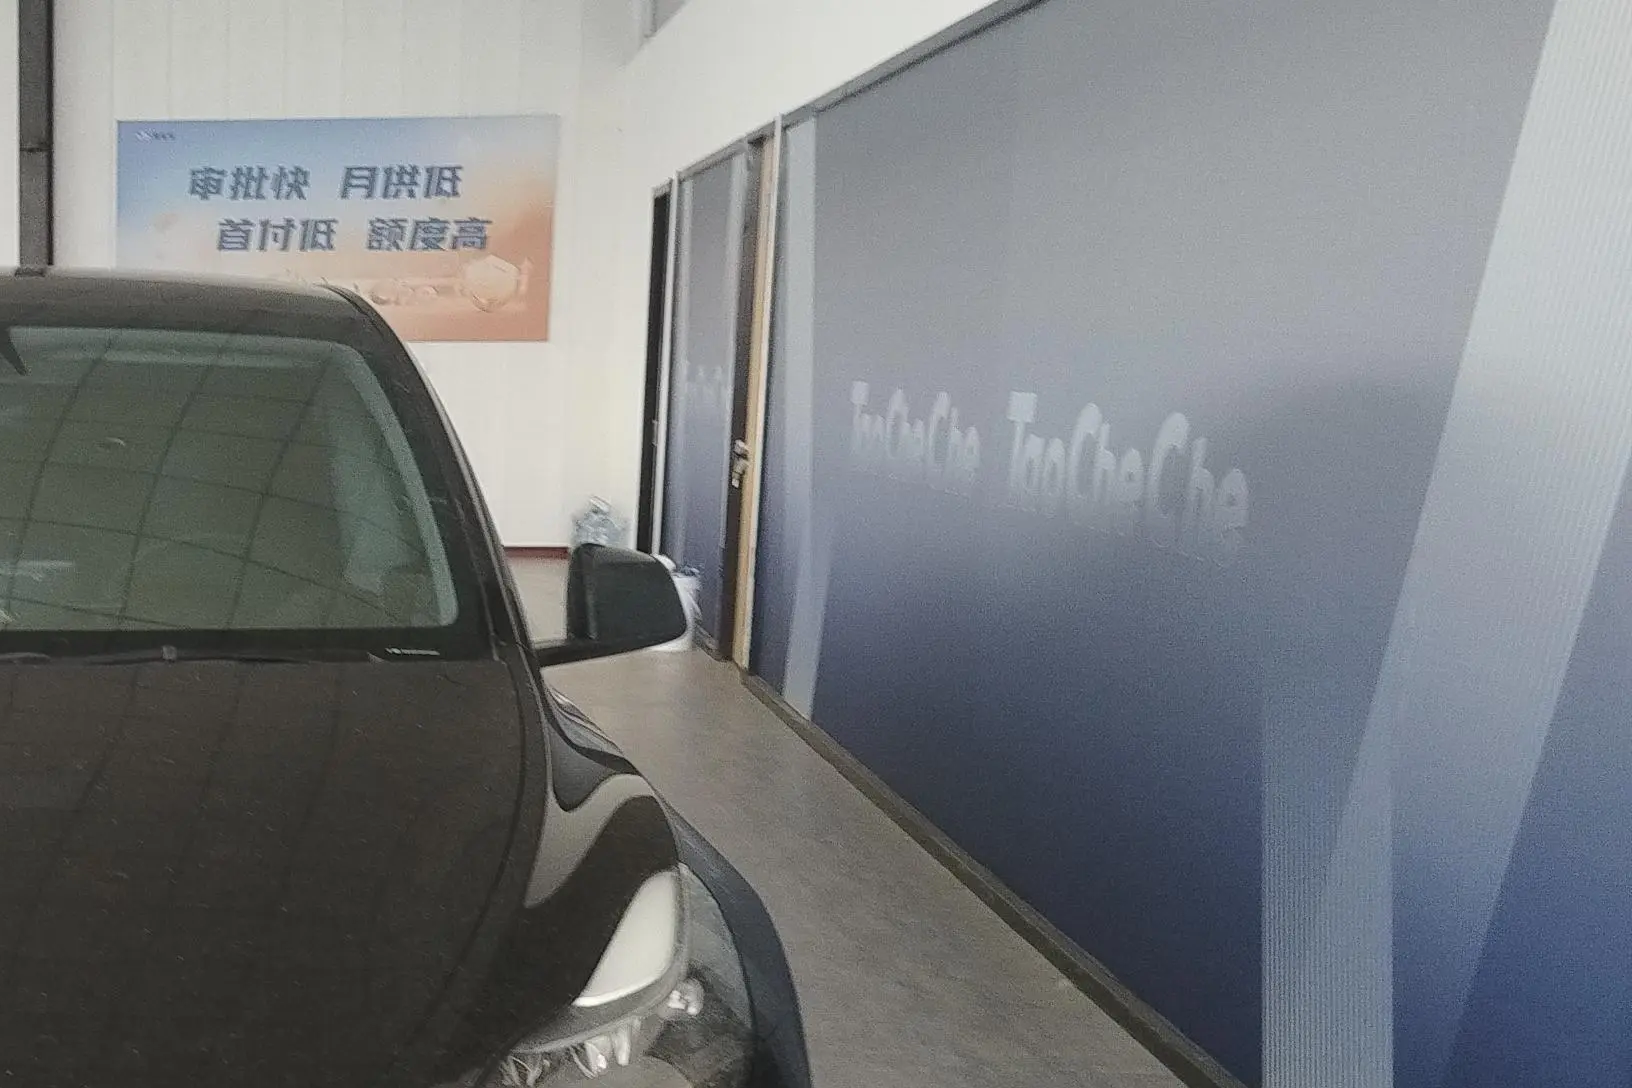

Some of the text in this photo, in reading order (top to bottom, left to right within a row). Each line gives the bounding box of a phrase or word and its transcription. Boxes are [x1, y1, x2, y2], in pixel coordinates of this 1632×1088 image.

[189, 164, 464, 200] 审批快 月供低
[217, 216, 494, 252] 首付低 额度高
[1006, 391, 1249, 537] TaoCheChe
